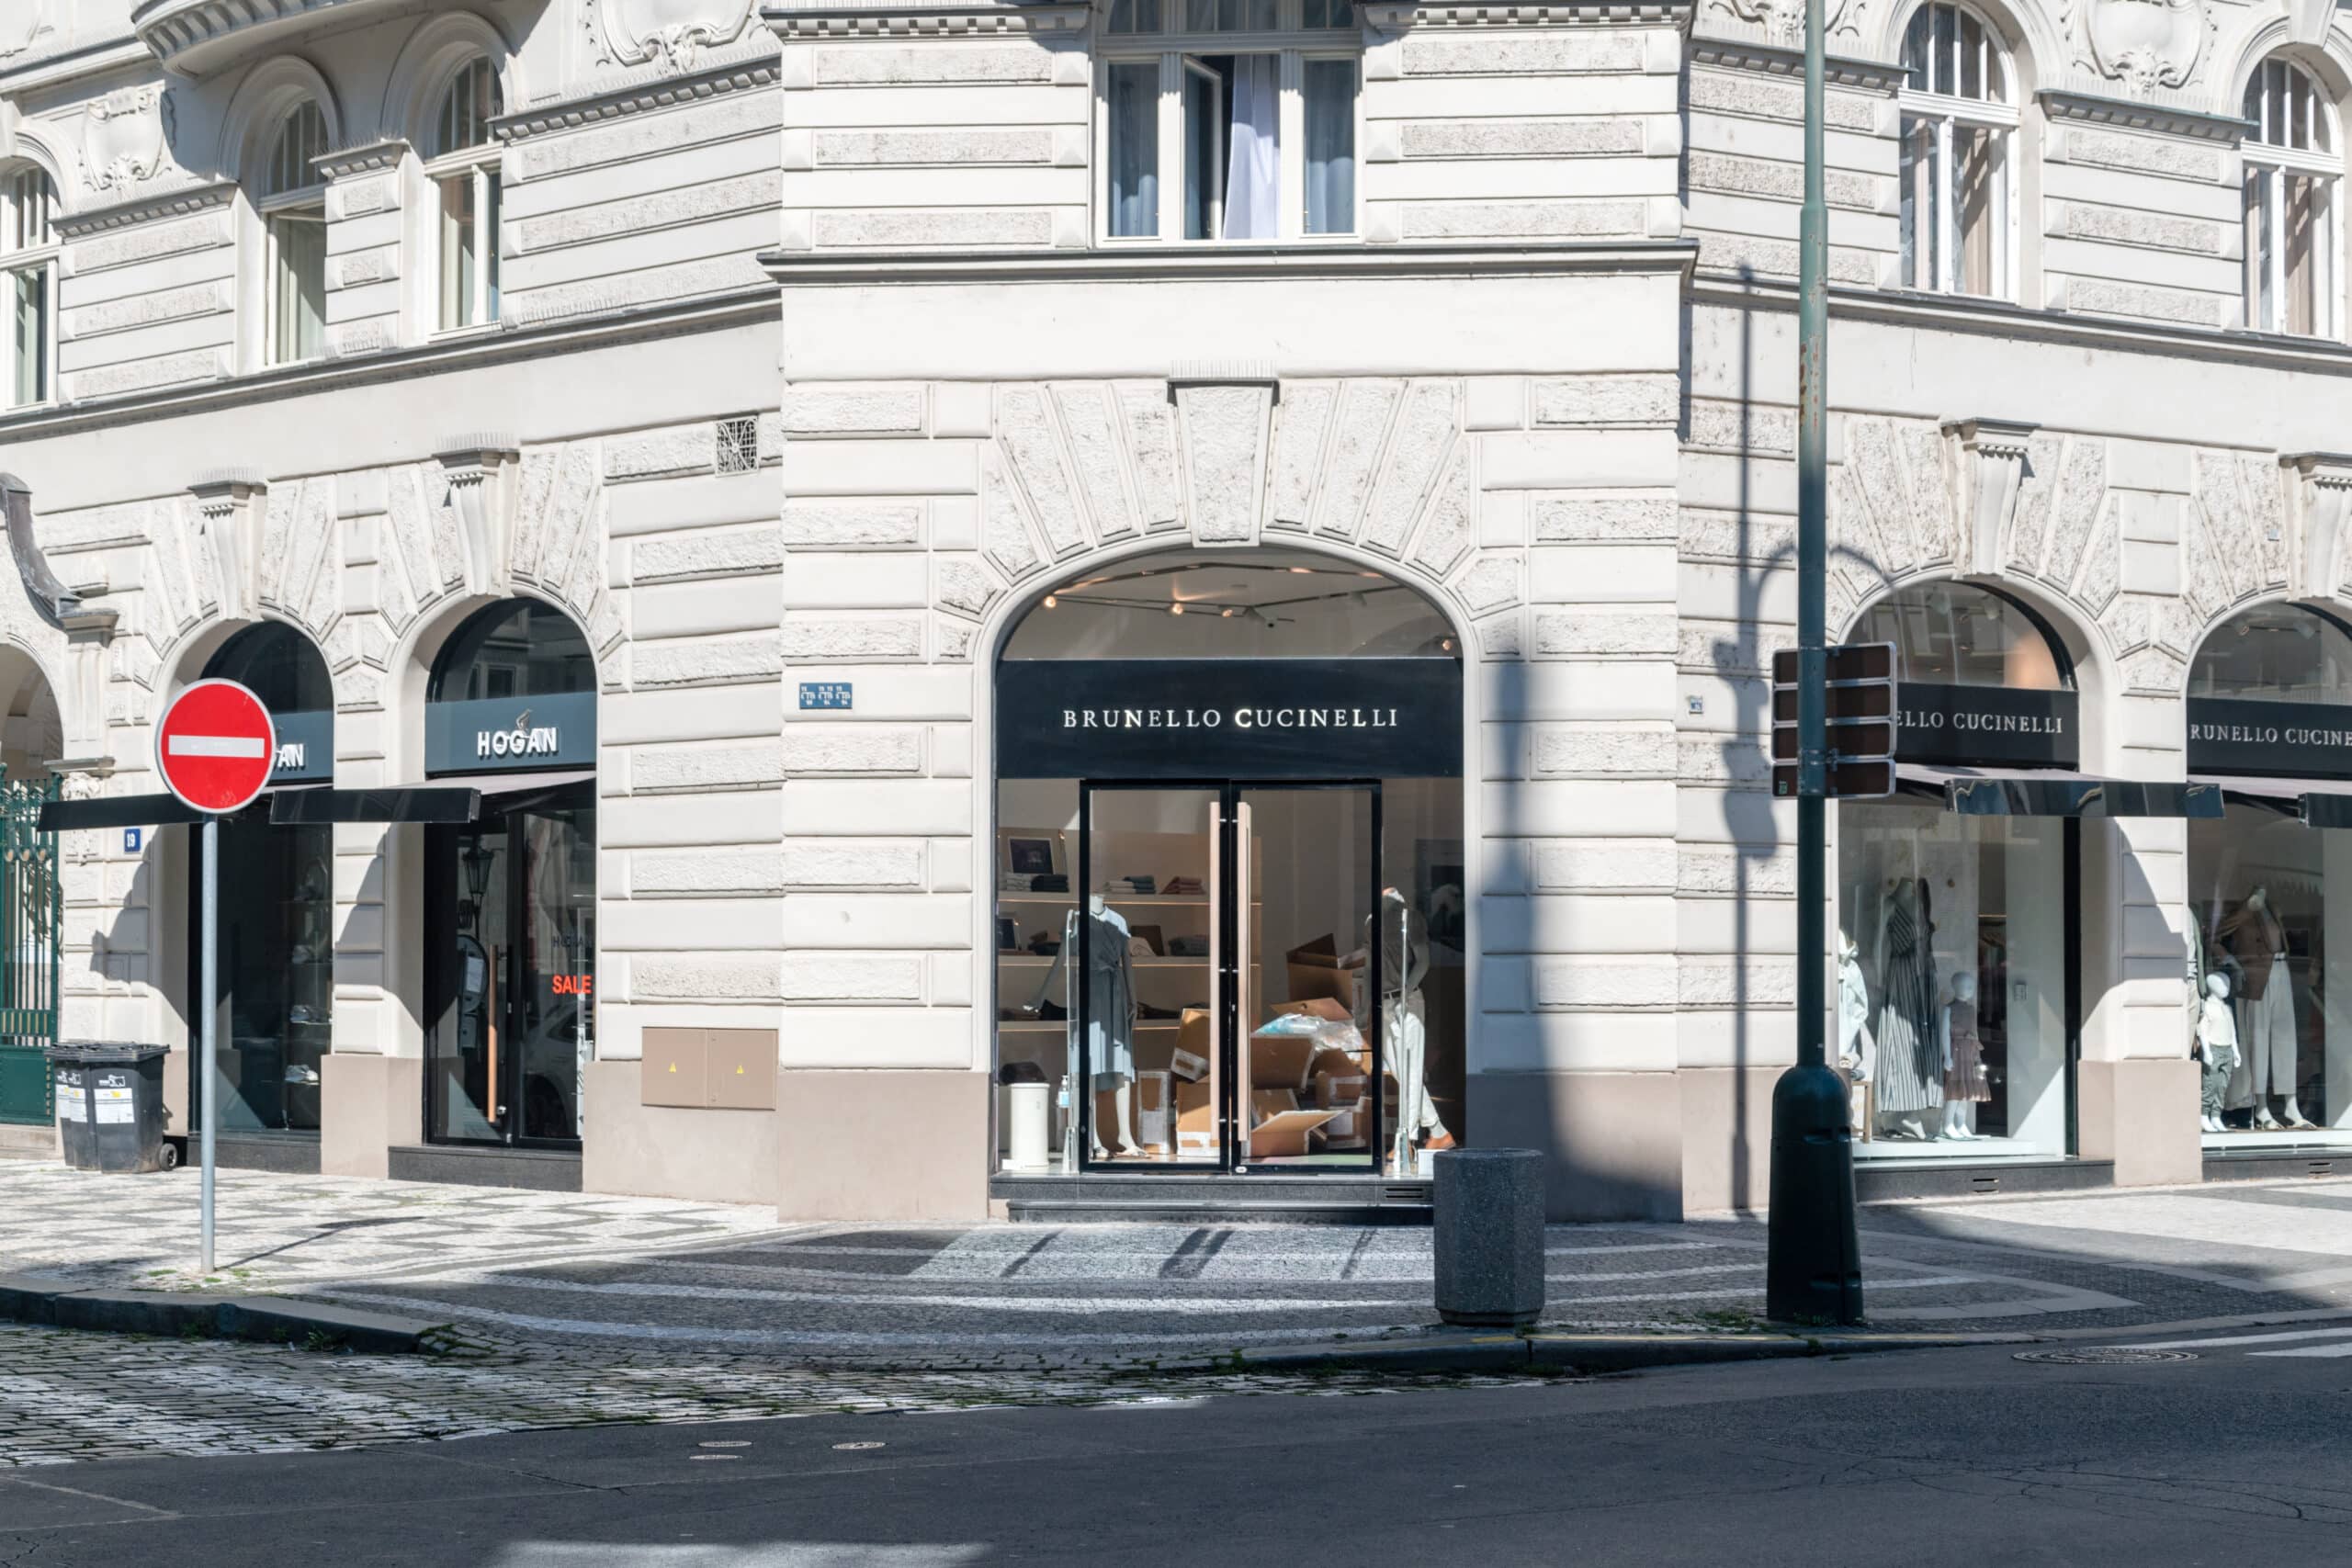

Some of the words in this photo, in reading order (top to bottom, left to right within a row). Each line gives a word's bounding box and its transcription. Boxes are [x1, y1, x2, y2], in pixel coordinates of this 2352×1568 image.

[1063, 708, 1221, 728] BRUNELLO
[1235, 708, 1397, 728] CUCINELLI
[1953, 712, 2063, 734] CUCINELLI
[477, 727, 558, 756] HOGAN
[552, 974, 594, 995] SALE
